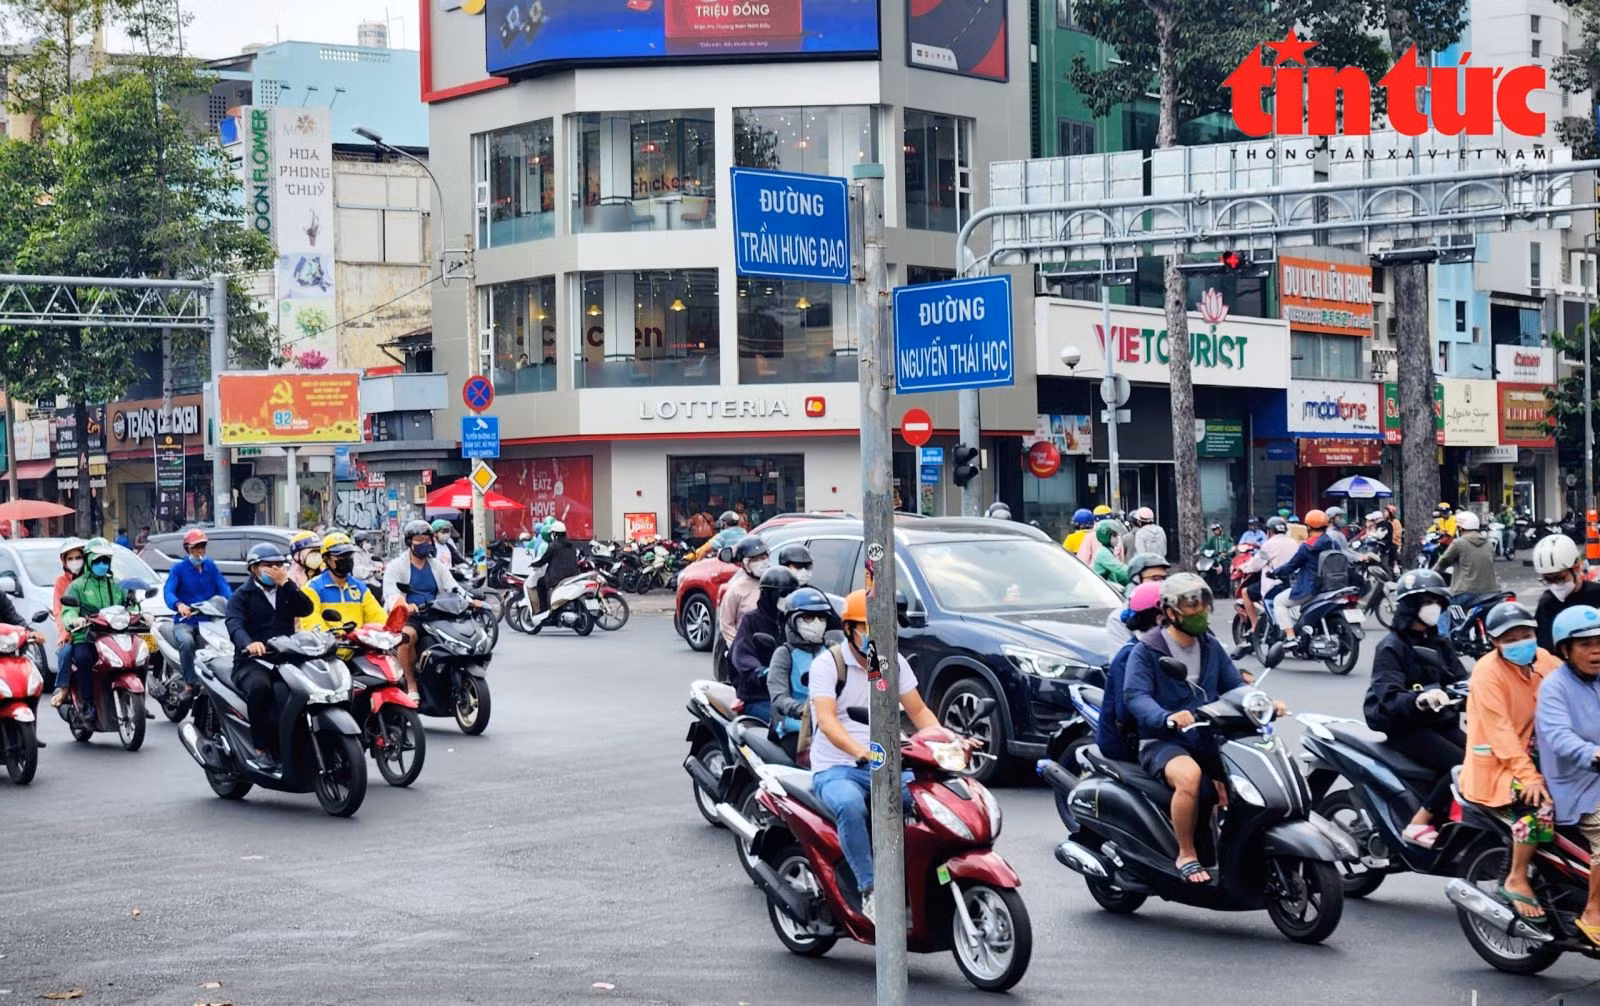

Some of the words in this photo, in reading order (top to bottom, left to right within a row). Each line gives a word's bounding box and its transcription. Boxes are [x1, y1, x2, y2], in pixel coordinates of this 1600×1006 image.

[695, 4, 729, 19] TRIỆU
[732, 2, 770, 16] ĐỒNG
[252, 109, 269, 183] FLOWER
[289, 147, 321, 161] HOA
[280, 165, 330, 179] PHONG
[253, 185, 270, 233] OON
[759, 186, 824, 217] ĐƯỜNG
[741, 221, 779, 264] TRẦN
[781, 234, 817, 267] HƯNG
[820, 238, 845, 274] ĐẠO
[1284, 265, 1300, 296] DU
[1300, 267, 1322, 304] LỊCH
[1323, 265, 1344, 302] LIÊN
[1345, 273, 1372, 304] BANG
[919, 295, 985, 327] ĐƯỜNG
[901, 335, 948, 379] NGUYỄN
[950, 334, 979, 375] THÁI
[982, 340, 1007, 378] HỌC
[127, 407, 156, 444] TEXAS
[157, 405, 199, 434] CCKEN
[274, 410, 292, 426] 92
[639, 399, 790, 420] LOTTERIA
[533, 478, 552, 490] EATZ
[530, 501, 556, 516] HAVE
